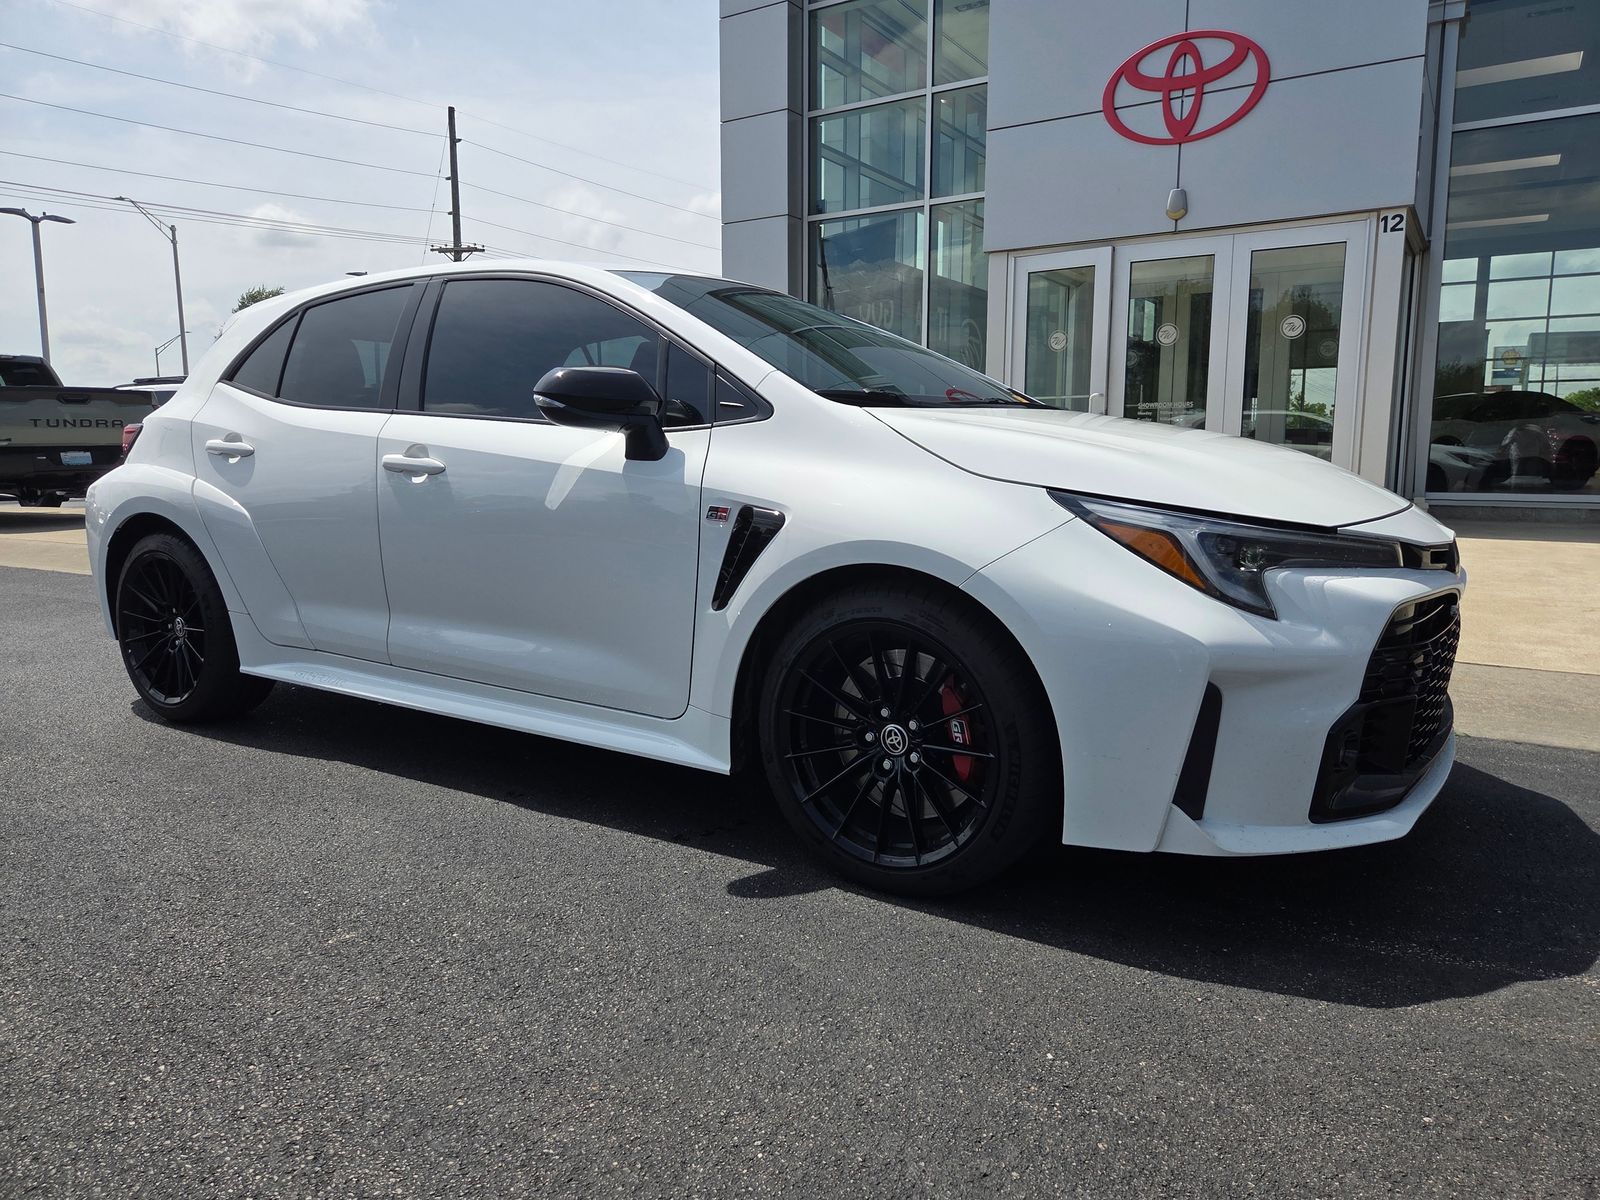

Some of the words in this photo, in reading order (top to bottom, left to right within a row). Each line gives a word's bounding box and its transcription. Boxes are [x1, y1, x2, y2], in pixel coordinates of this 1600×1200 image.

[1381, 213, 1404, 233] 12
[1137, 402, 1173, 410] SHOWROOM
[1173, 401, 1195, 409] HOURS
[30, 418, 124, 428] TUNDRA
[952, 719, 964, 744] GR
